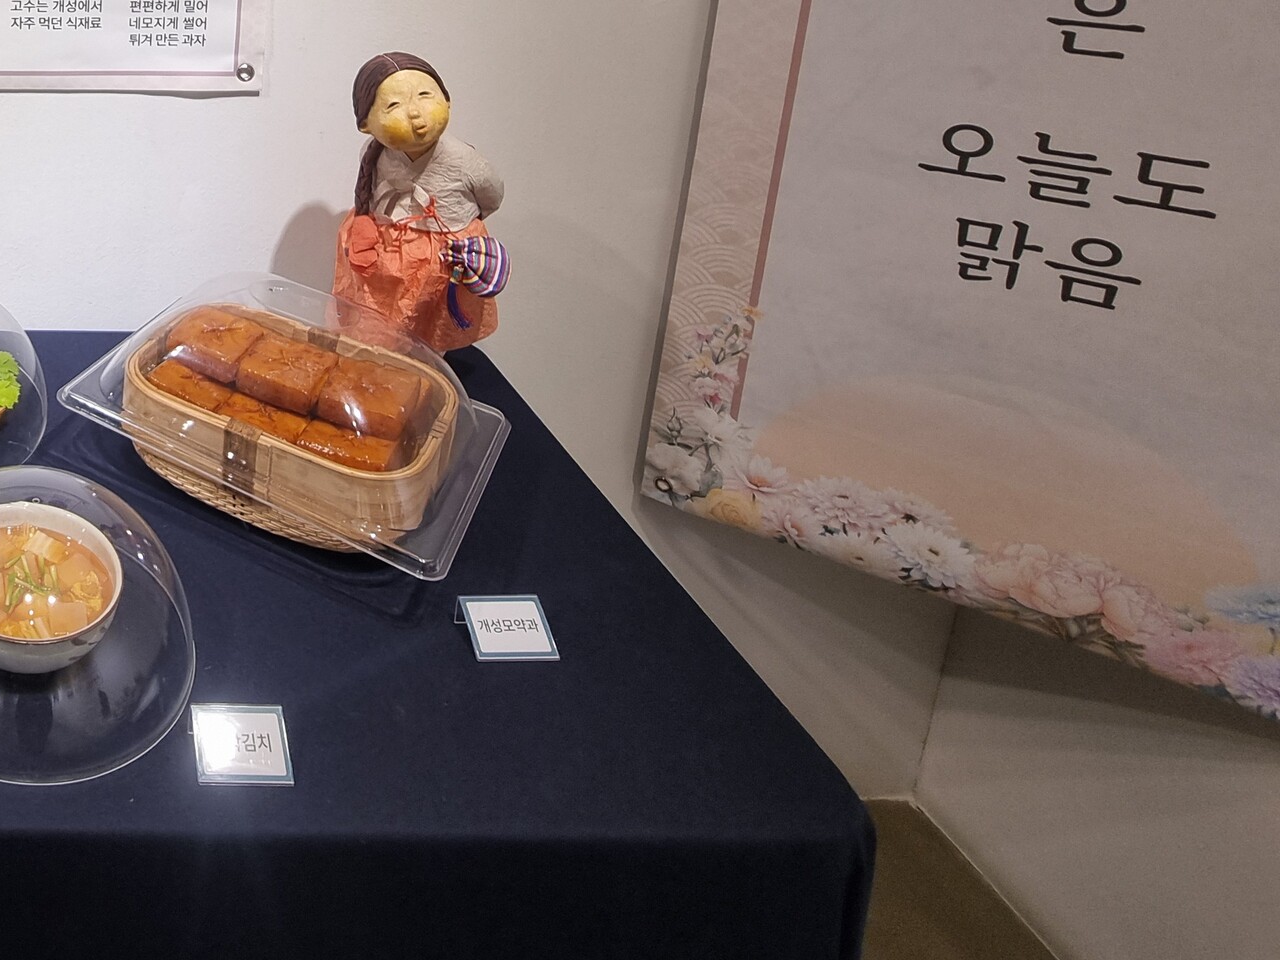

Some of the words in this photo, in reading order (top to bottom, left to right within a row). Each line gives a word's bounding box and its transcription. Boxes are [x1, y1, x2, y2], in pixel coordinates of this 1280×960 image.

[11, 0, 49, 12] 고수는
[53, 0, 103, 13] 개성에서
[130, 0, 179, 13] 편편하게
[184, 0, 208, 13] 밀어
[11, 17, 35, 30] 자주
[39, 17, 62, 30] 먹던
[66, 17, 102, 30] 식재료
[129, 17, 178, 30] 네모지게
[182, 17, 207, 30] 썰어
[129, 34, 152, 46] 튀겨
[156, 34, 178, 47] 만든
[182, 34, 206, 47] 과자
[918, 124, 1217, 219] 오늘도
[956, 217, 1142, 310] 맑음
[477, 618, 539, 634] 개성모약과
[236, 732, 273, 752] 김치
